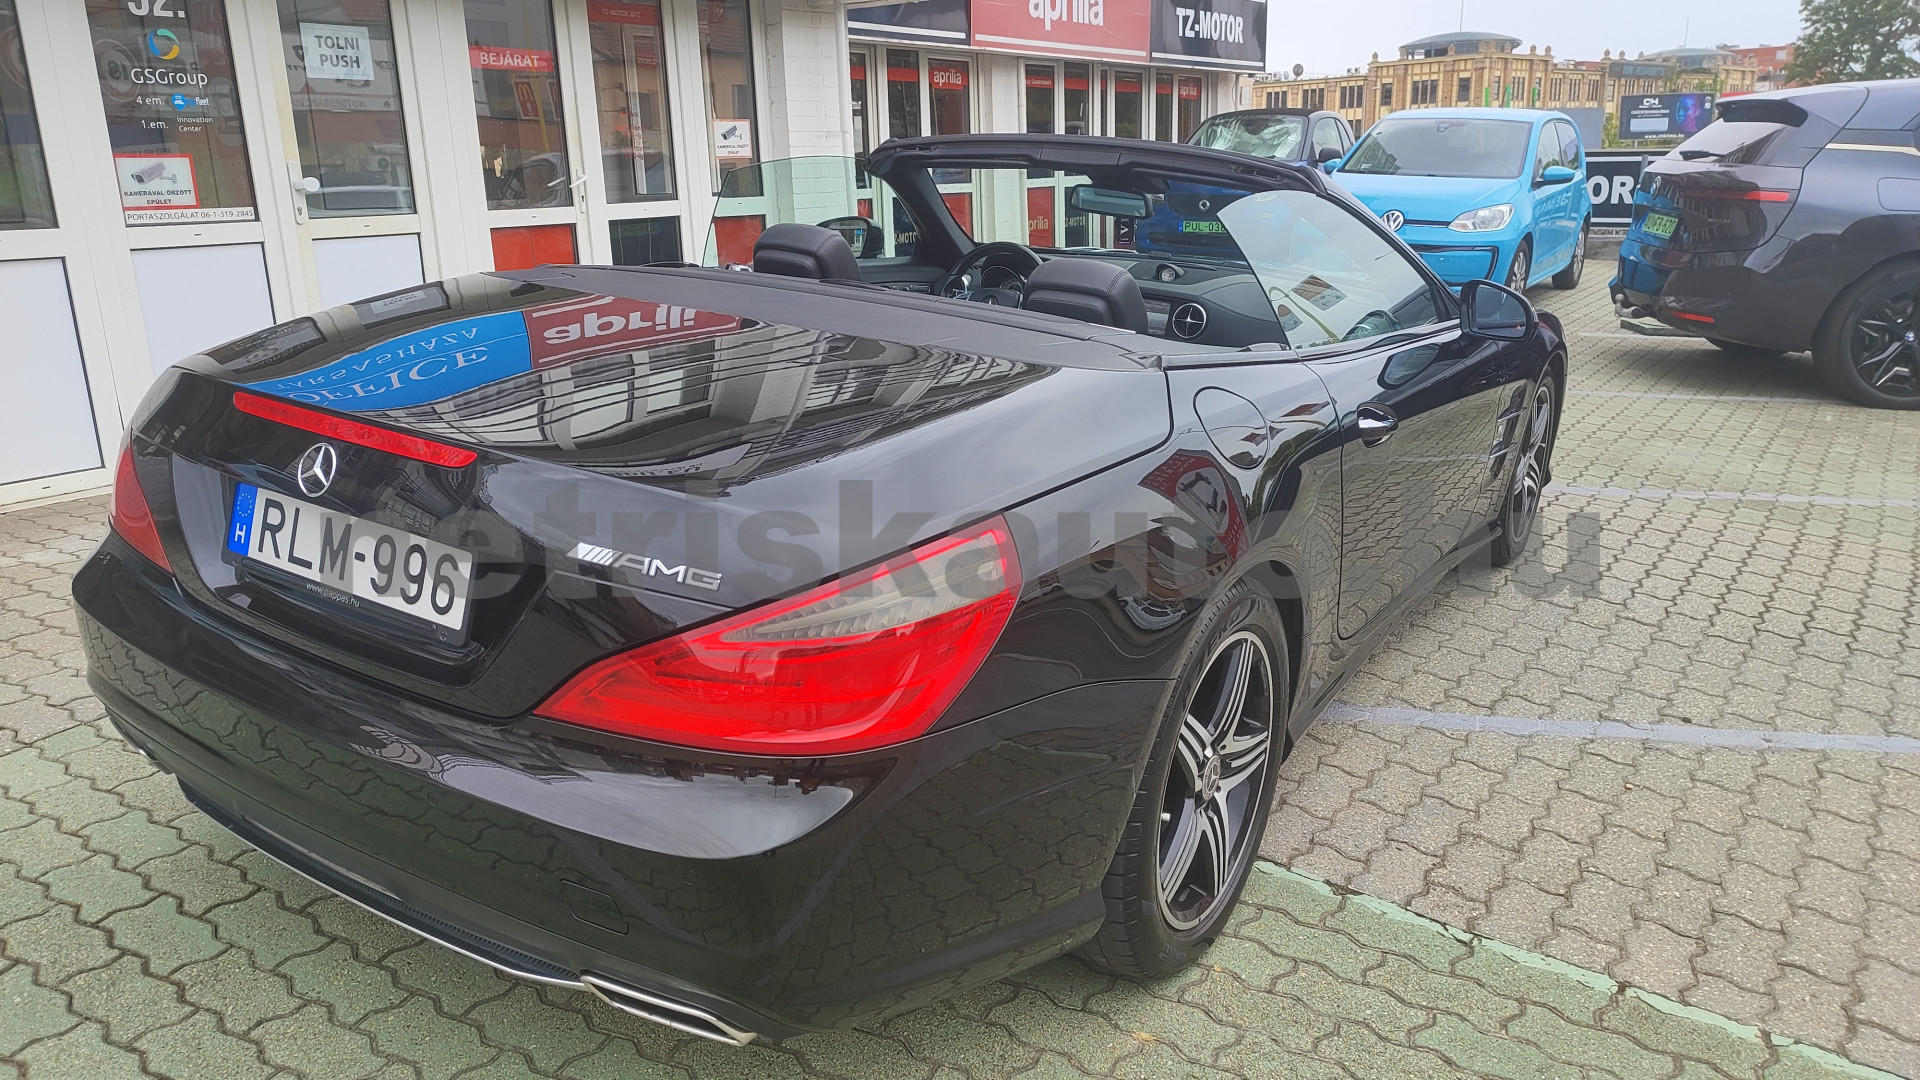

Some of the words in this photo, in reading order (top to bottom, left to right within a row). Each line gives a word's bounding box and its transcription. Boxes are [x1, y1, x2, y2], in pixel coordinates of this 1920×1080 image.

[1028, 0, 1103, 30] aprilia
[1176, 7, 1244, 44] TZ-MOTOR
[314, 35, 360, 51] TOLNI
[319, 53, 361, 69] PUSH
[480, 50, 539, 68] BEJÁRAT
[131, 68, 208, 88] GSGroup
[933, 68, 962, 87] aprilia
[136, 95, 143, 105] 4
[127, 210, 200, 221] PORTASZOLGÁLAT
[200, 209, 254, 219] 06-1-319-2845
[234, 522, 246, 544] H
[257, 497, 459, 616] RLM-996
[613, 553, 723, 592] AMG
[306, 581, 361, 608] www.pappas.hu
